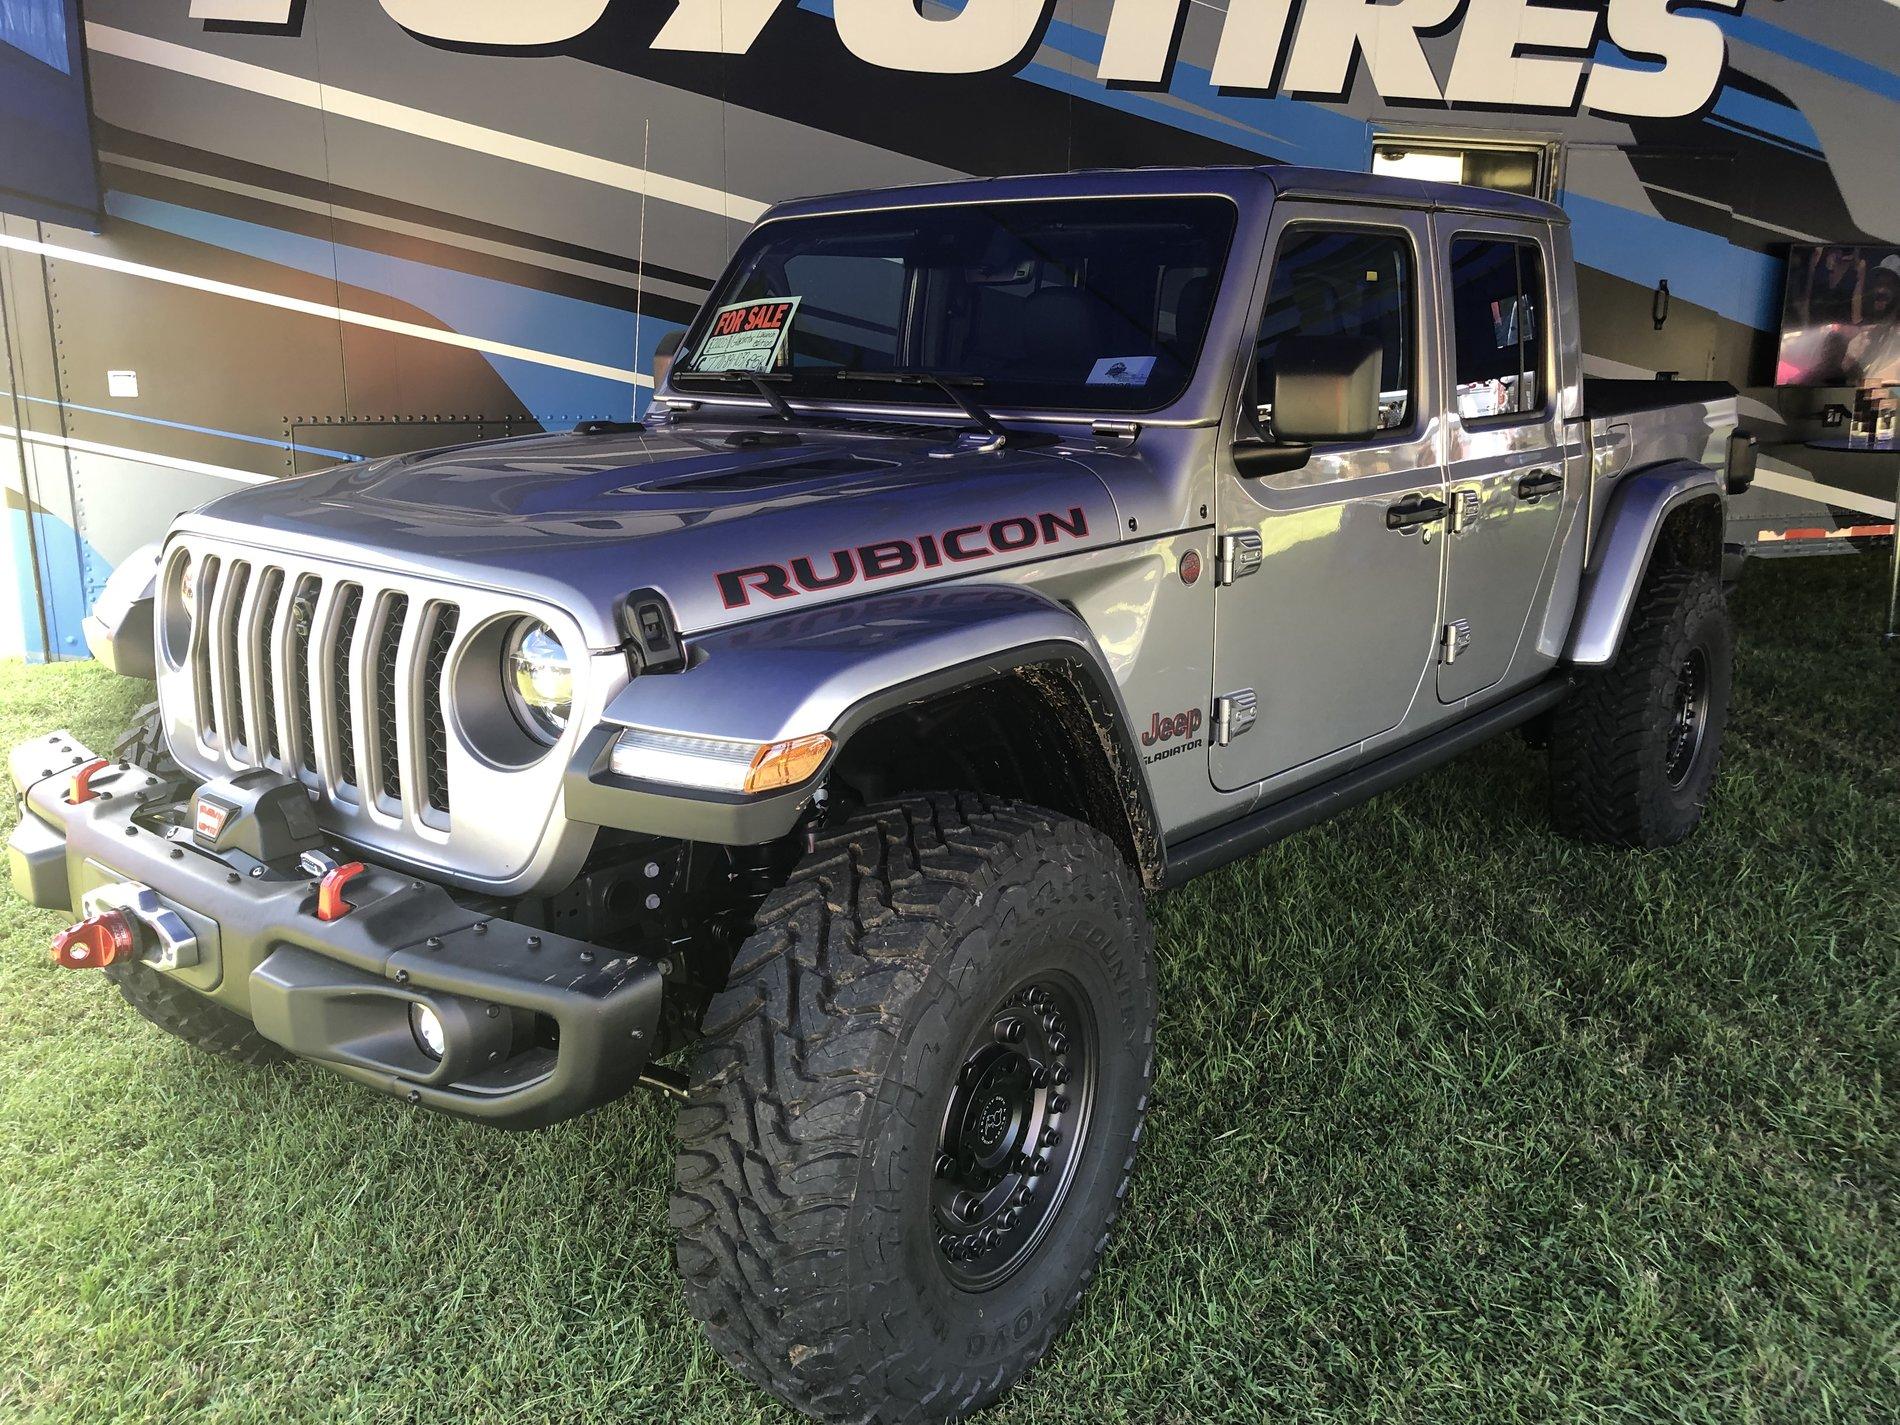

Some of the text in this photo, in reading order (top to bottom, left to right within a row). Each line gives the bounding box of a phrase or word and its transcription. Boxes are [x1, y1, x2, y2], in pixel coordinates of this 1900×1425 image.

[714, 304, 789, 335] FOR SALE
[714, 505, 1090, 609] RUBICON
[1142, 708, 1202, 746] Jeep
[1068, 918, 1136, 1057] COUNTRY
